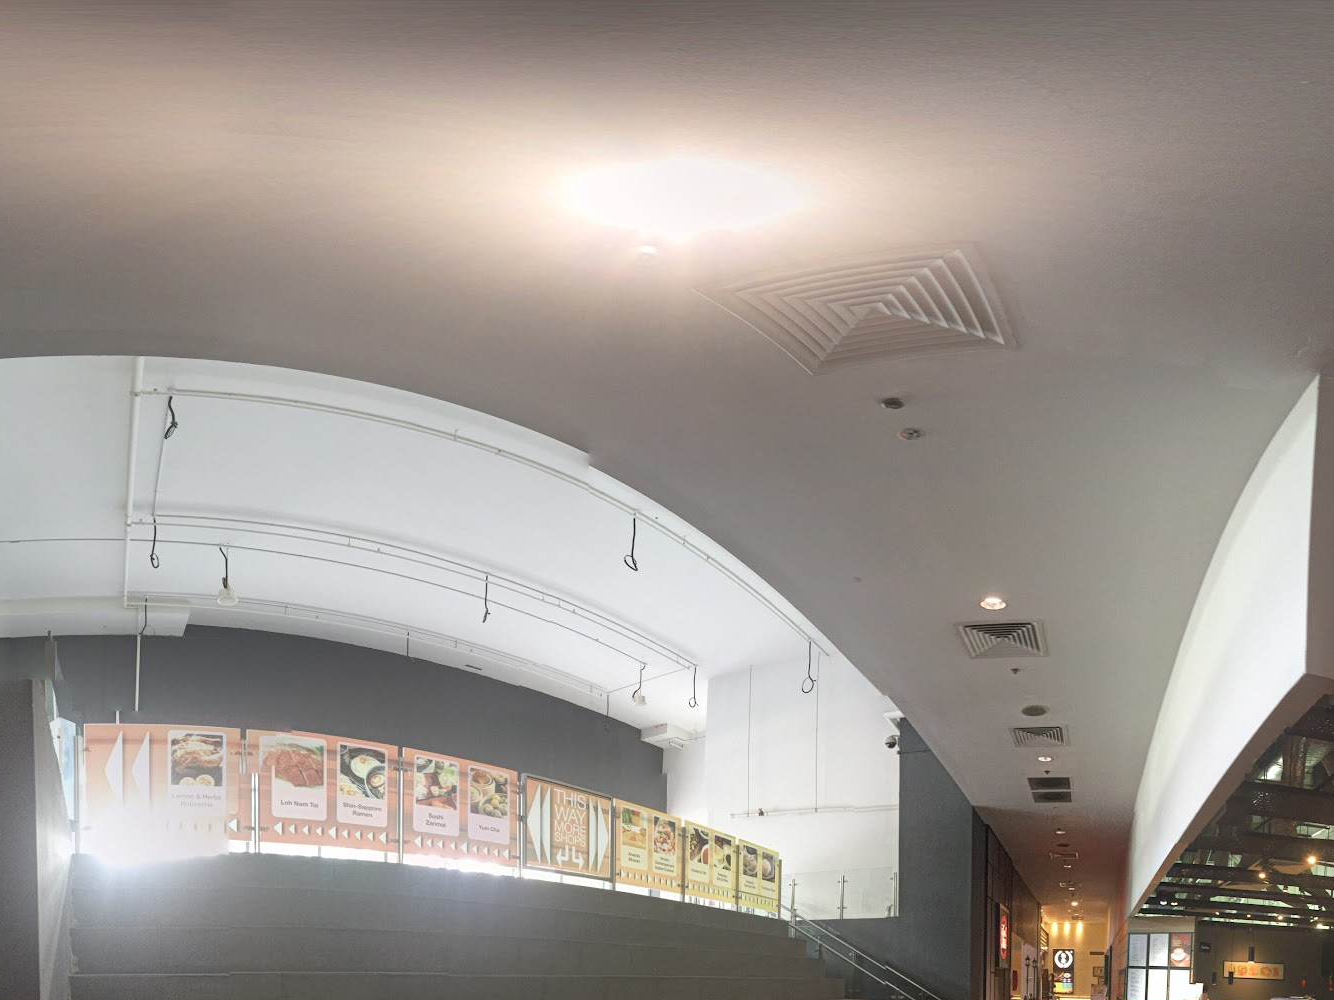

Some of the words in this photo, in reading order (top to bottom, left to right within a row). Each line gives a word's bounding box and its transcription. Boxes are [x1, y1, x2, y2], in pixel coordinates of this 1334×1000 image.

[280, 799, 292, 807] Loh
[554, 788, 587, 810] THIS
[343, 802, 382, 813] Shin-Sapporo
[352, 810, 373, 818] Ramen
[428, 812, 444, 820] Sushi
[555, 805, 587, 825] WAY
[425, 820, 447, 828] Zanmai
[478, 824, 489, 832] Yum
[555, 820, 587, 837] MORE
[555, 832, 587, 846] SHOPS
